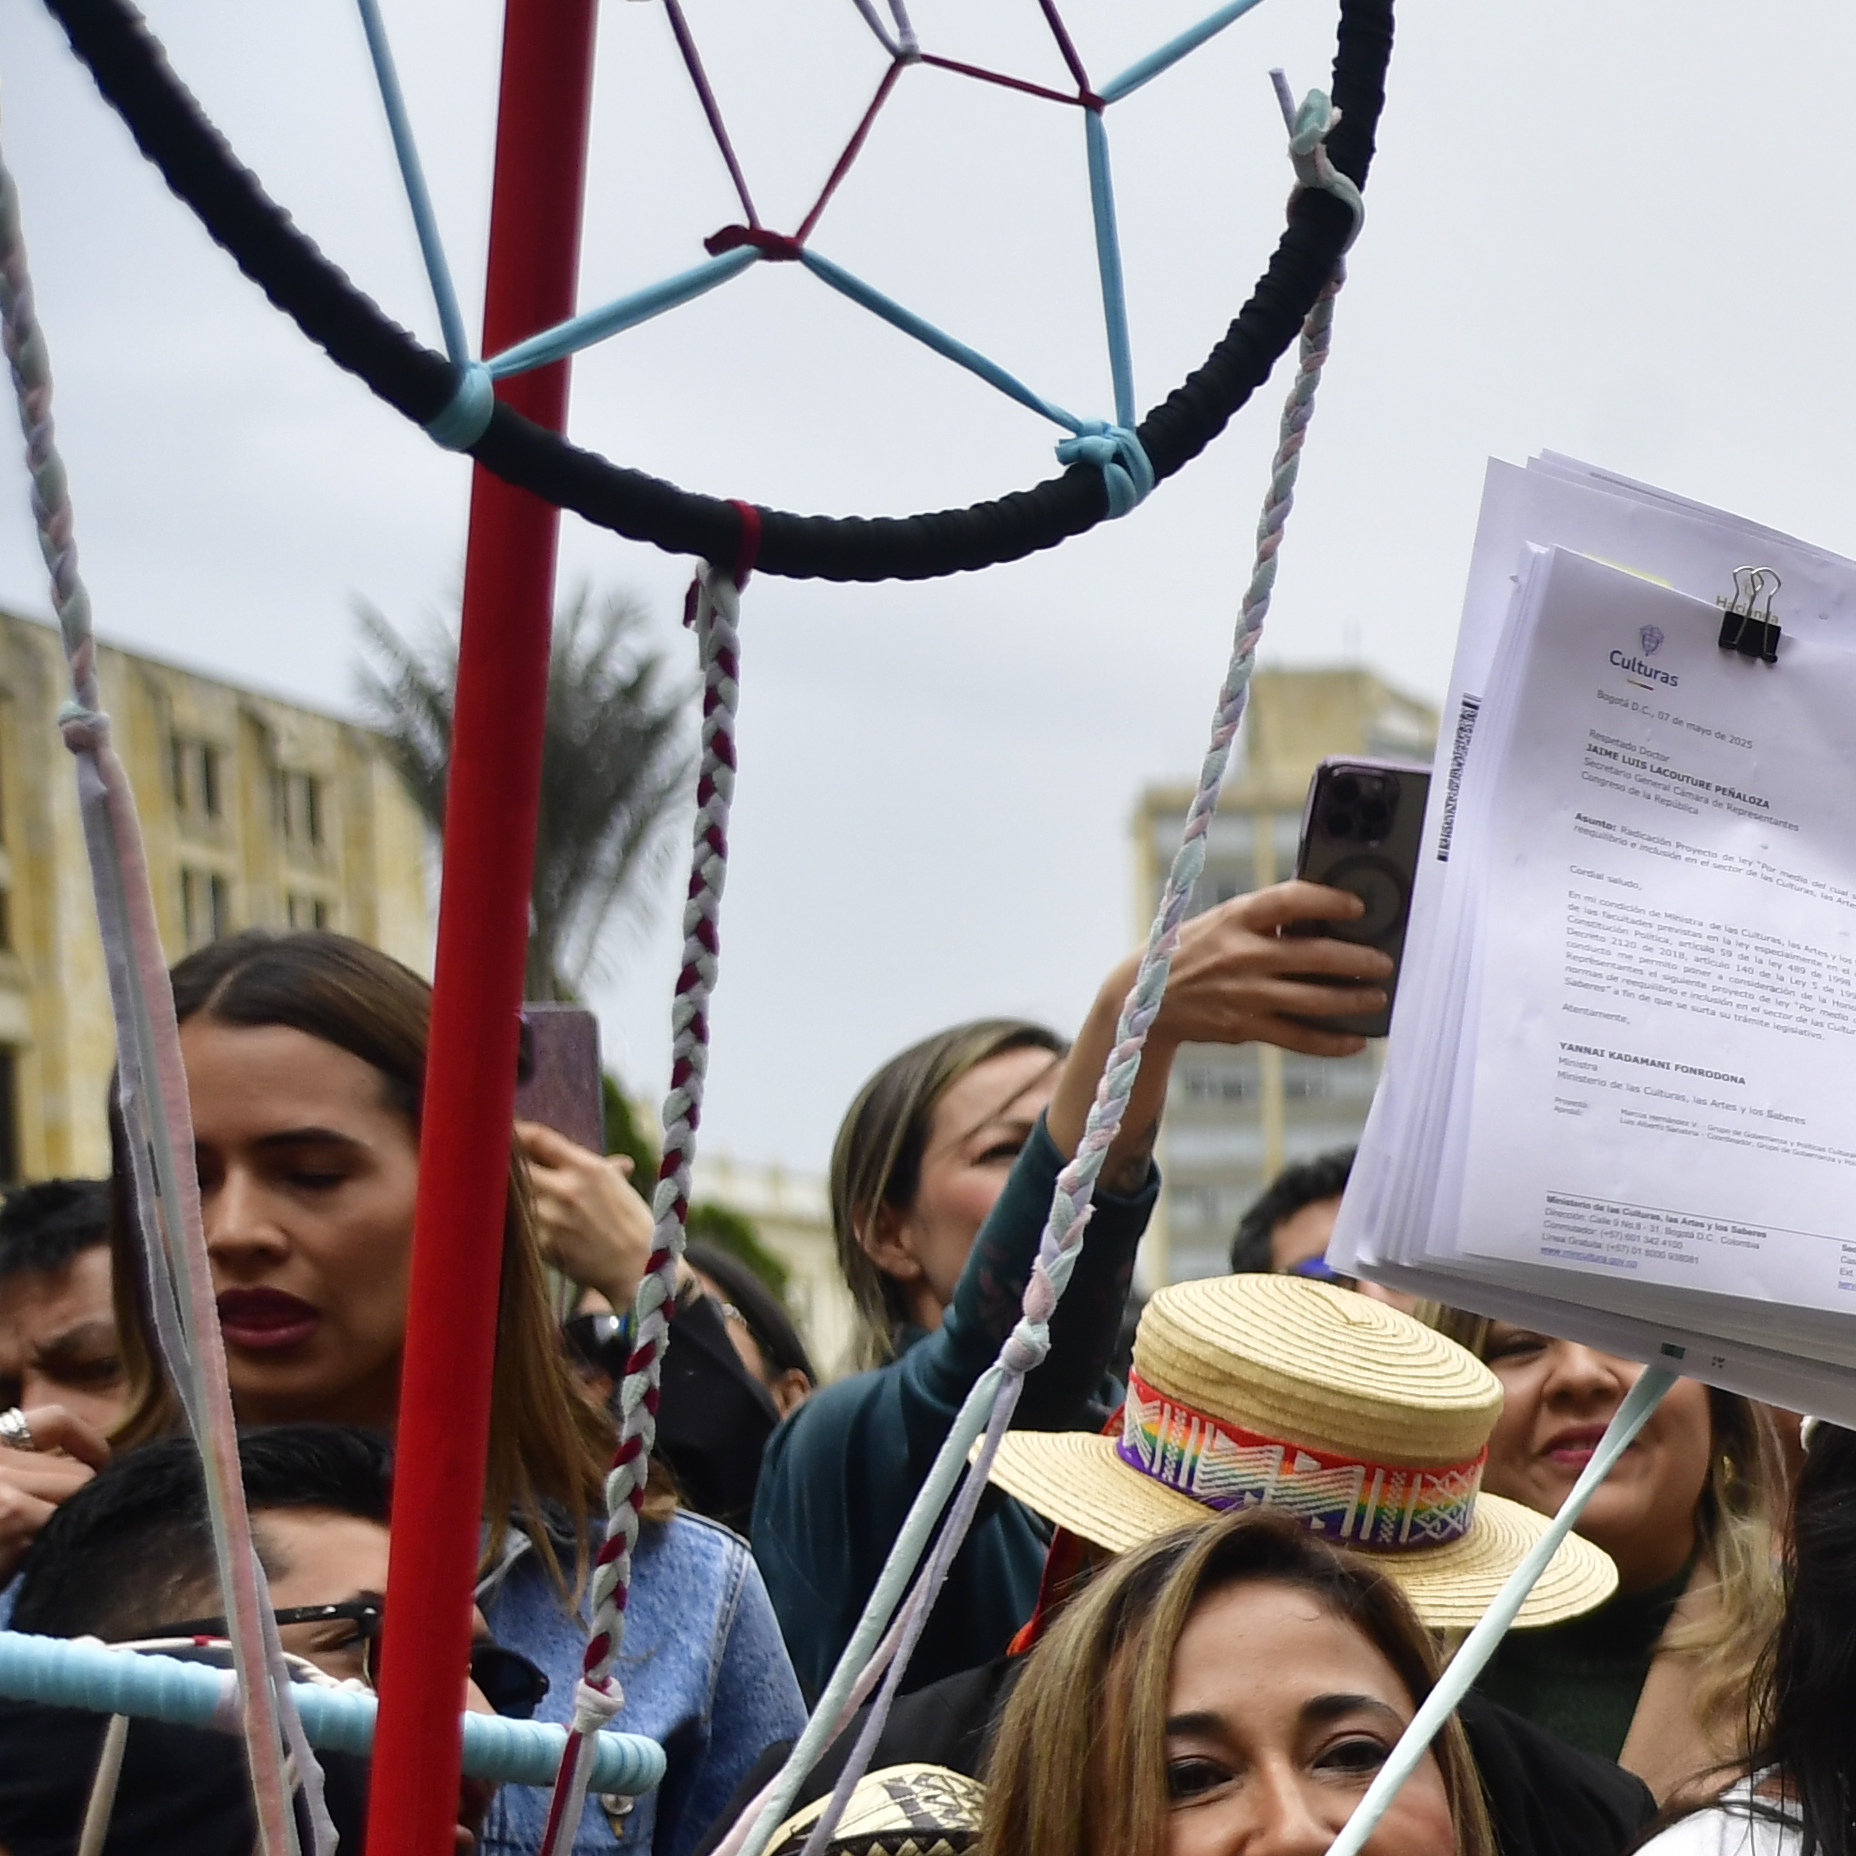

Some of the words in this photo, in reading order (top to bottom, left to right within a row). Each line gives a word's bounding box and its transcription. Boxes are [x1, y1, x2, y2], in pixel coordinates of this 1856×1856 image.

[1715, 595, 1779, 625] Hacina
[1608, 648, 1679, 688] Culturas
[1595, 687, 1630, 709] Bogotá
[1629, 699, 1655, 719] D.C.,
[1655, 709, 1672, 723] 07
[1670, 715, 1685, 728] de
[1684, 720, 1713, 737] mayo
[1712, 729, 1727, 742] de
[1727, 732, 1754, 750] 2025
[1587, 727, 1638, 753] Respetado
[1637, 744, 1671, 764] Doctor
[1579, 769, 1627, 793] Congreso
[1626, 785, 1642, 797] de
[1640, 789, 1652, 801] la
[1652, 792, 1700, 816] República
[1582, 755, 1633, 780] Secretario
[1632, 772, 1672, 793] General
[1671, 784, 1710, 805] Cámara
[1710, 797, 1725, 810] de
[1724, 800, 1800, 833] Representantes
[1584, 741, 1620, 762] JAIME
[1620, 753, 1648, 771] LUIS
[1648, 762, 1713, 792] LACOUTURE
[1712, 783, 1770, 810] PEÑALOZA
[1567, 863, 1606, 881] Cordial
[1605, 874, 1643, 892] saludo,
[1571, 823, 1629, 847] reequilibrio
[1637, 842, 1683, 862] inclusión
[1682, 855, 1699, 865] en
[1698, 858, 1711, 868] el
[1710, 861, 1745, 874] sector
[1744, 867, 1759, 878] de
[1758, 871, 1775, 884] las
[1774, 876, 1817, 898] Culturas,
[1819, 890, 1835, 903] las
[1573, 811, 1617, 832] Asunto:
[1619, 823, 1673, 848] Radicación
[1673, 839, 1719, 860] Proyecto
[1720, 852, 1736, 863] de
[1737, 854, 1755, 868] ley
[1778, 869, 1809, 885] medio
[1810, 879, 1828, 890] del
[1827, 885, 1850, 898] cual
[1560, 1001, 1631, 1026] Atentamente,
[1556, 1054, 1599, 1073] Ministra
[1558, 1040, 1606, 1059] YANNAI
[1606, 1049, 1671, 1071] KADAMANI
[1672, 1062, 1747, 1086] FONRODONA
[1555, 1068, 1608, 1088] Ministerio
[1608, 1079, 1624, 1091] de
[1624, 1081, 1642, 1094] las
[1641, 1084, 1690, 1104] Culturas,
[1691, 1094, 1709, 1107] las
[1708, 1097, 1738, 1112] Artes
[1747, 1105, 1765, 1118] los
[1764, 1107, 1807, 1126] Saberes
